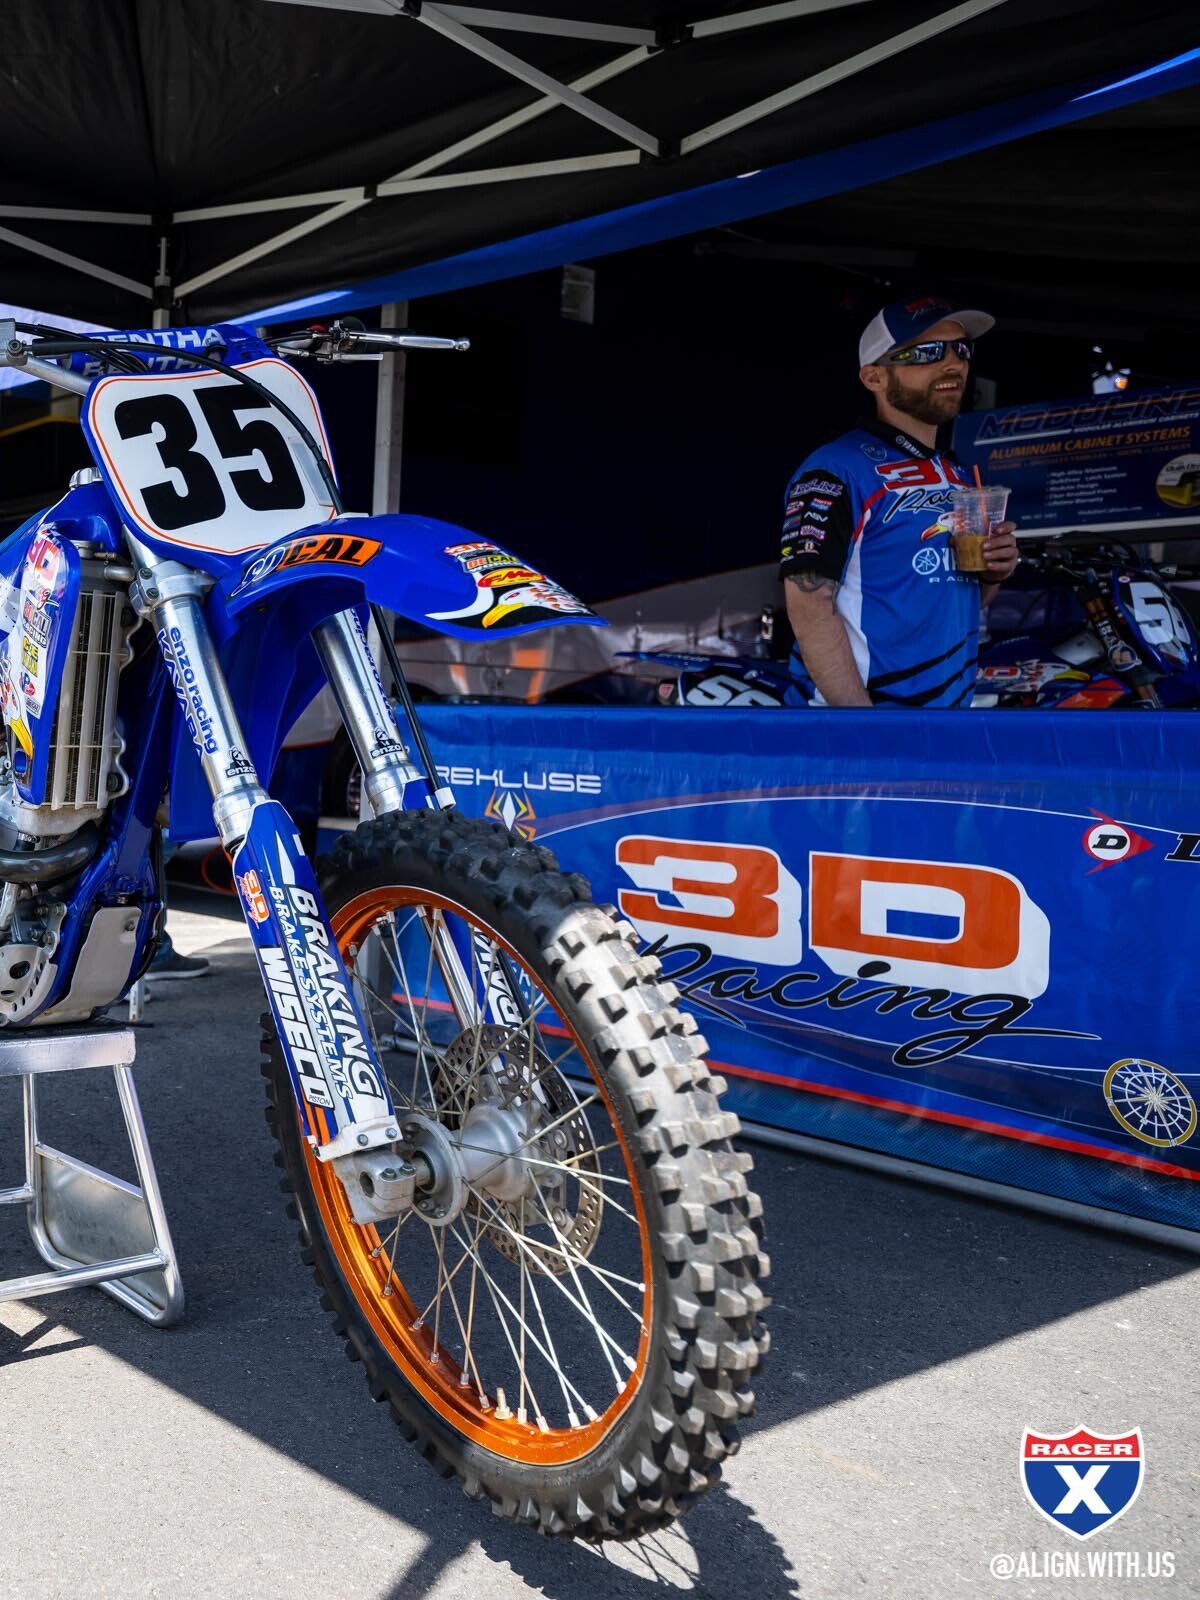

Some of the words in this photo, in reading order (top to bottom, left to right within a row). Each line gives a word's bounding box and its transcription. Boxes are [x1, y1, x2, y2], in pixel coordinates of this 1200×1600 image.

[114, 384, 306, 531] 35
[988, 440, 1062, 460] ALUMINUM
[1063, 433, 1124, 452] CABINET
[1126, 425, 1192, 444] SYSTEMS
[928, 576, 979, 585] RACIN
[168, 626, 195, 685] enzo
[187, 684, 220, 756] racing
[227, 766, 256, 778] enzo
[435, 765, 601, 795] REKLUSE
[244, 869, 270, 923] 3D
[615, 835, 1050, 1000] 3D
[269, 886, 309, 970] BRAKE
[298, 975, 354, 1099] SYSTEMS
[289, 884, 385, 1100] BRAKING
[637, 934, 1102, 1069] Racing
[308, 1095, 331, 1106] PISTON
